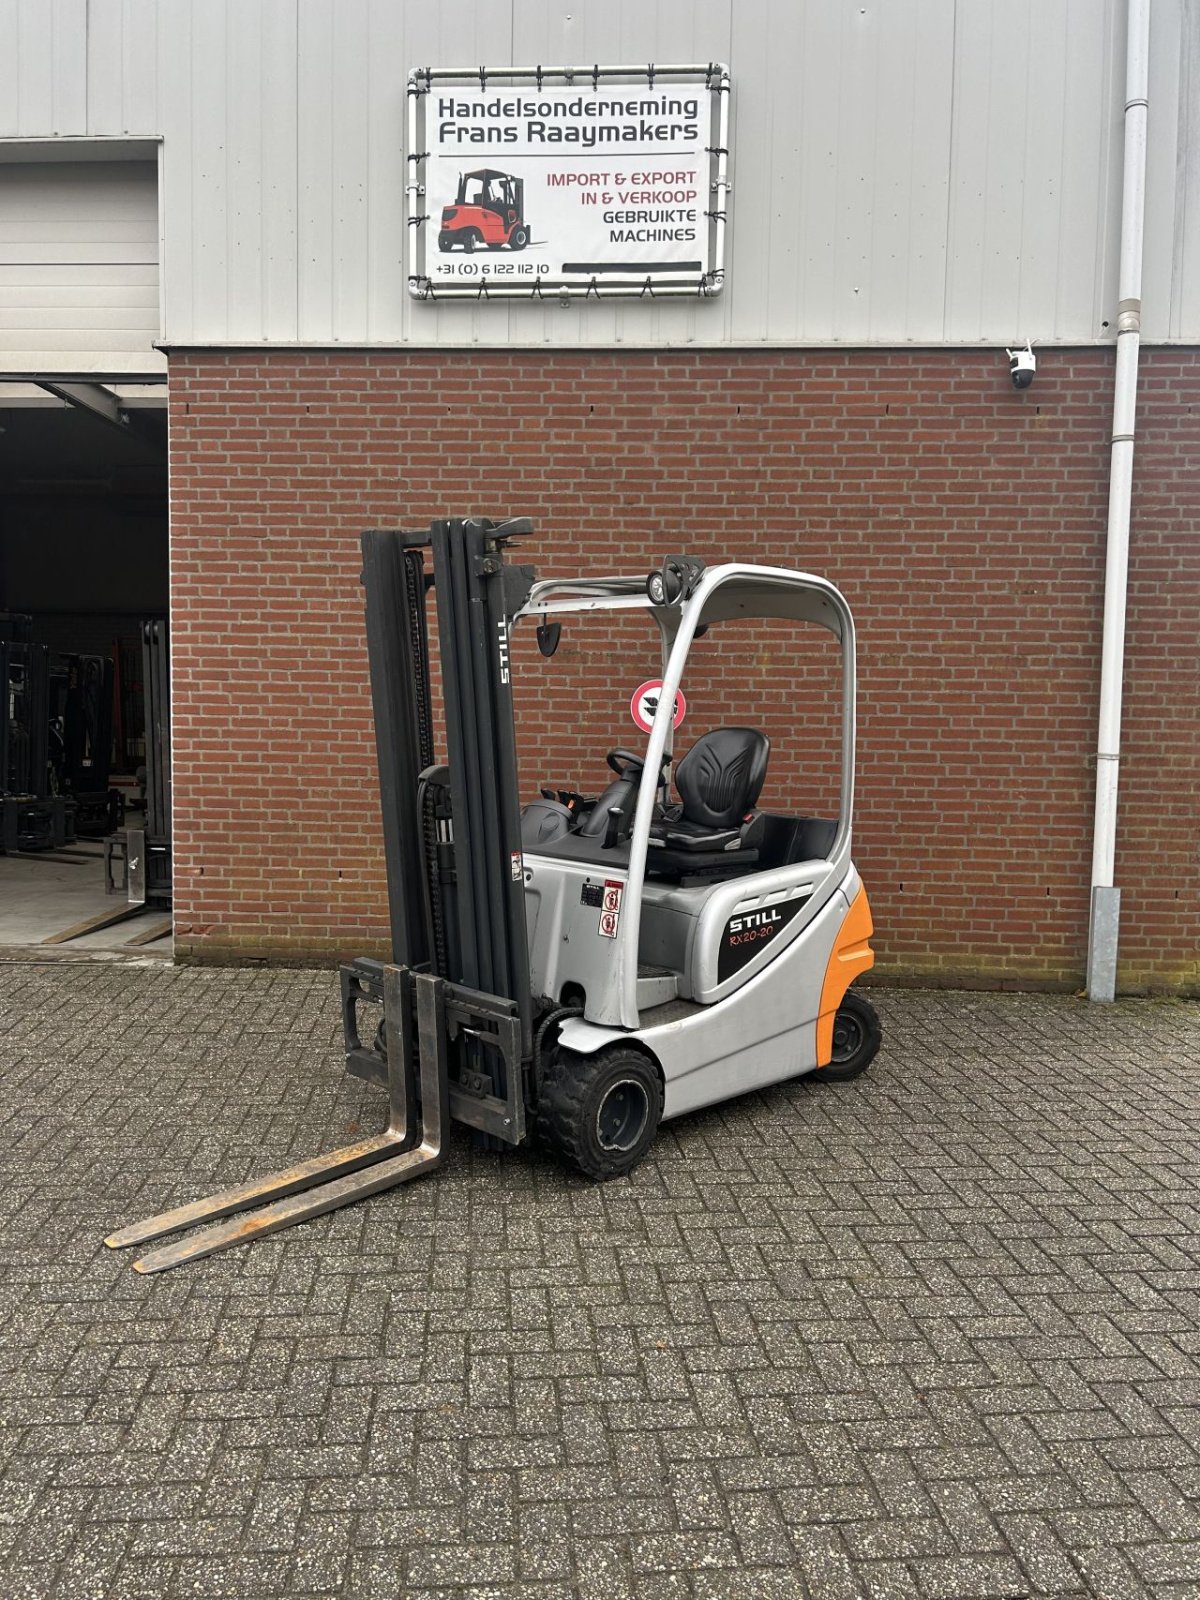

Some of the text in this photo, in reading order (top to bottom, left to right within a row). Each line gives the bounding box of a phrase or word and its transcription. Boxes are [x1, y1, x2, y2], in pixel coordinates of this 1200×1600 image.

[438, 96, 698, 119] Handelsonderneming
[438, 119, 698, 147] Frans Raaymakers
[546, 171, 697, 187] IMPORT & EXPORT
[581, 190, 697, 205] IN & VERKOOP
[602, 209, 697, 224] GEBRUIKTE
[609, 228, 696, 243] MACHINES
[436, 263, 550, 275] +31 (0) 6 122 112 10
[497, 613, 509, 684] STILL
[729, 909, 782, 933] STILL
